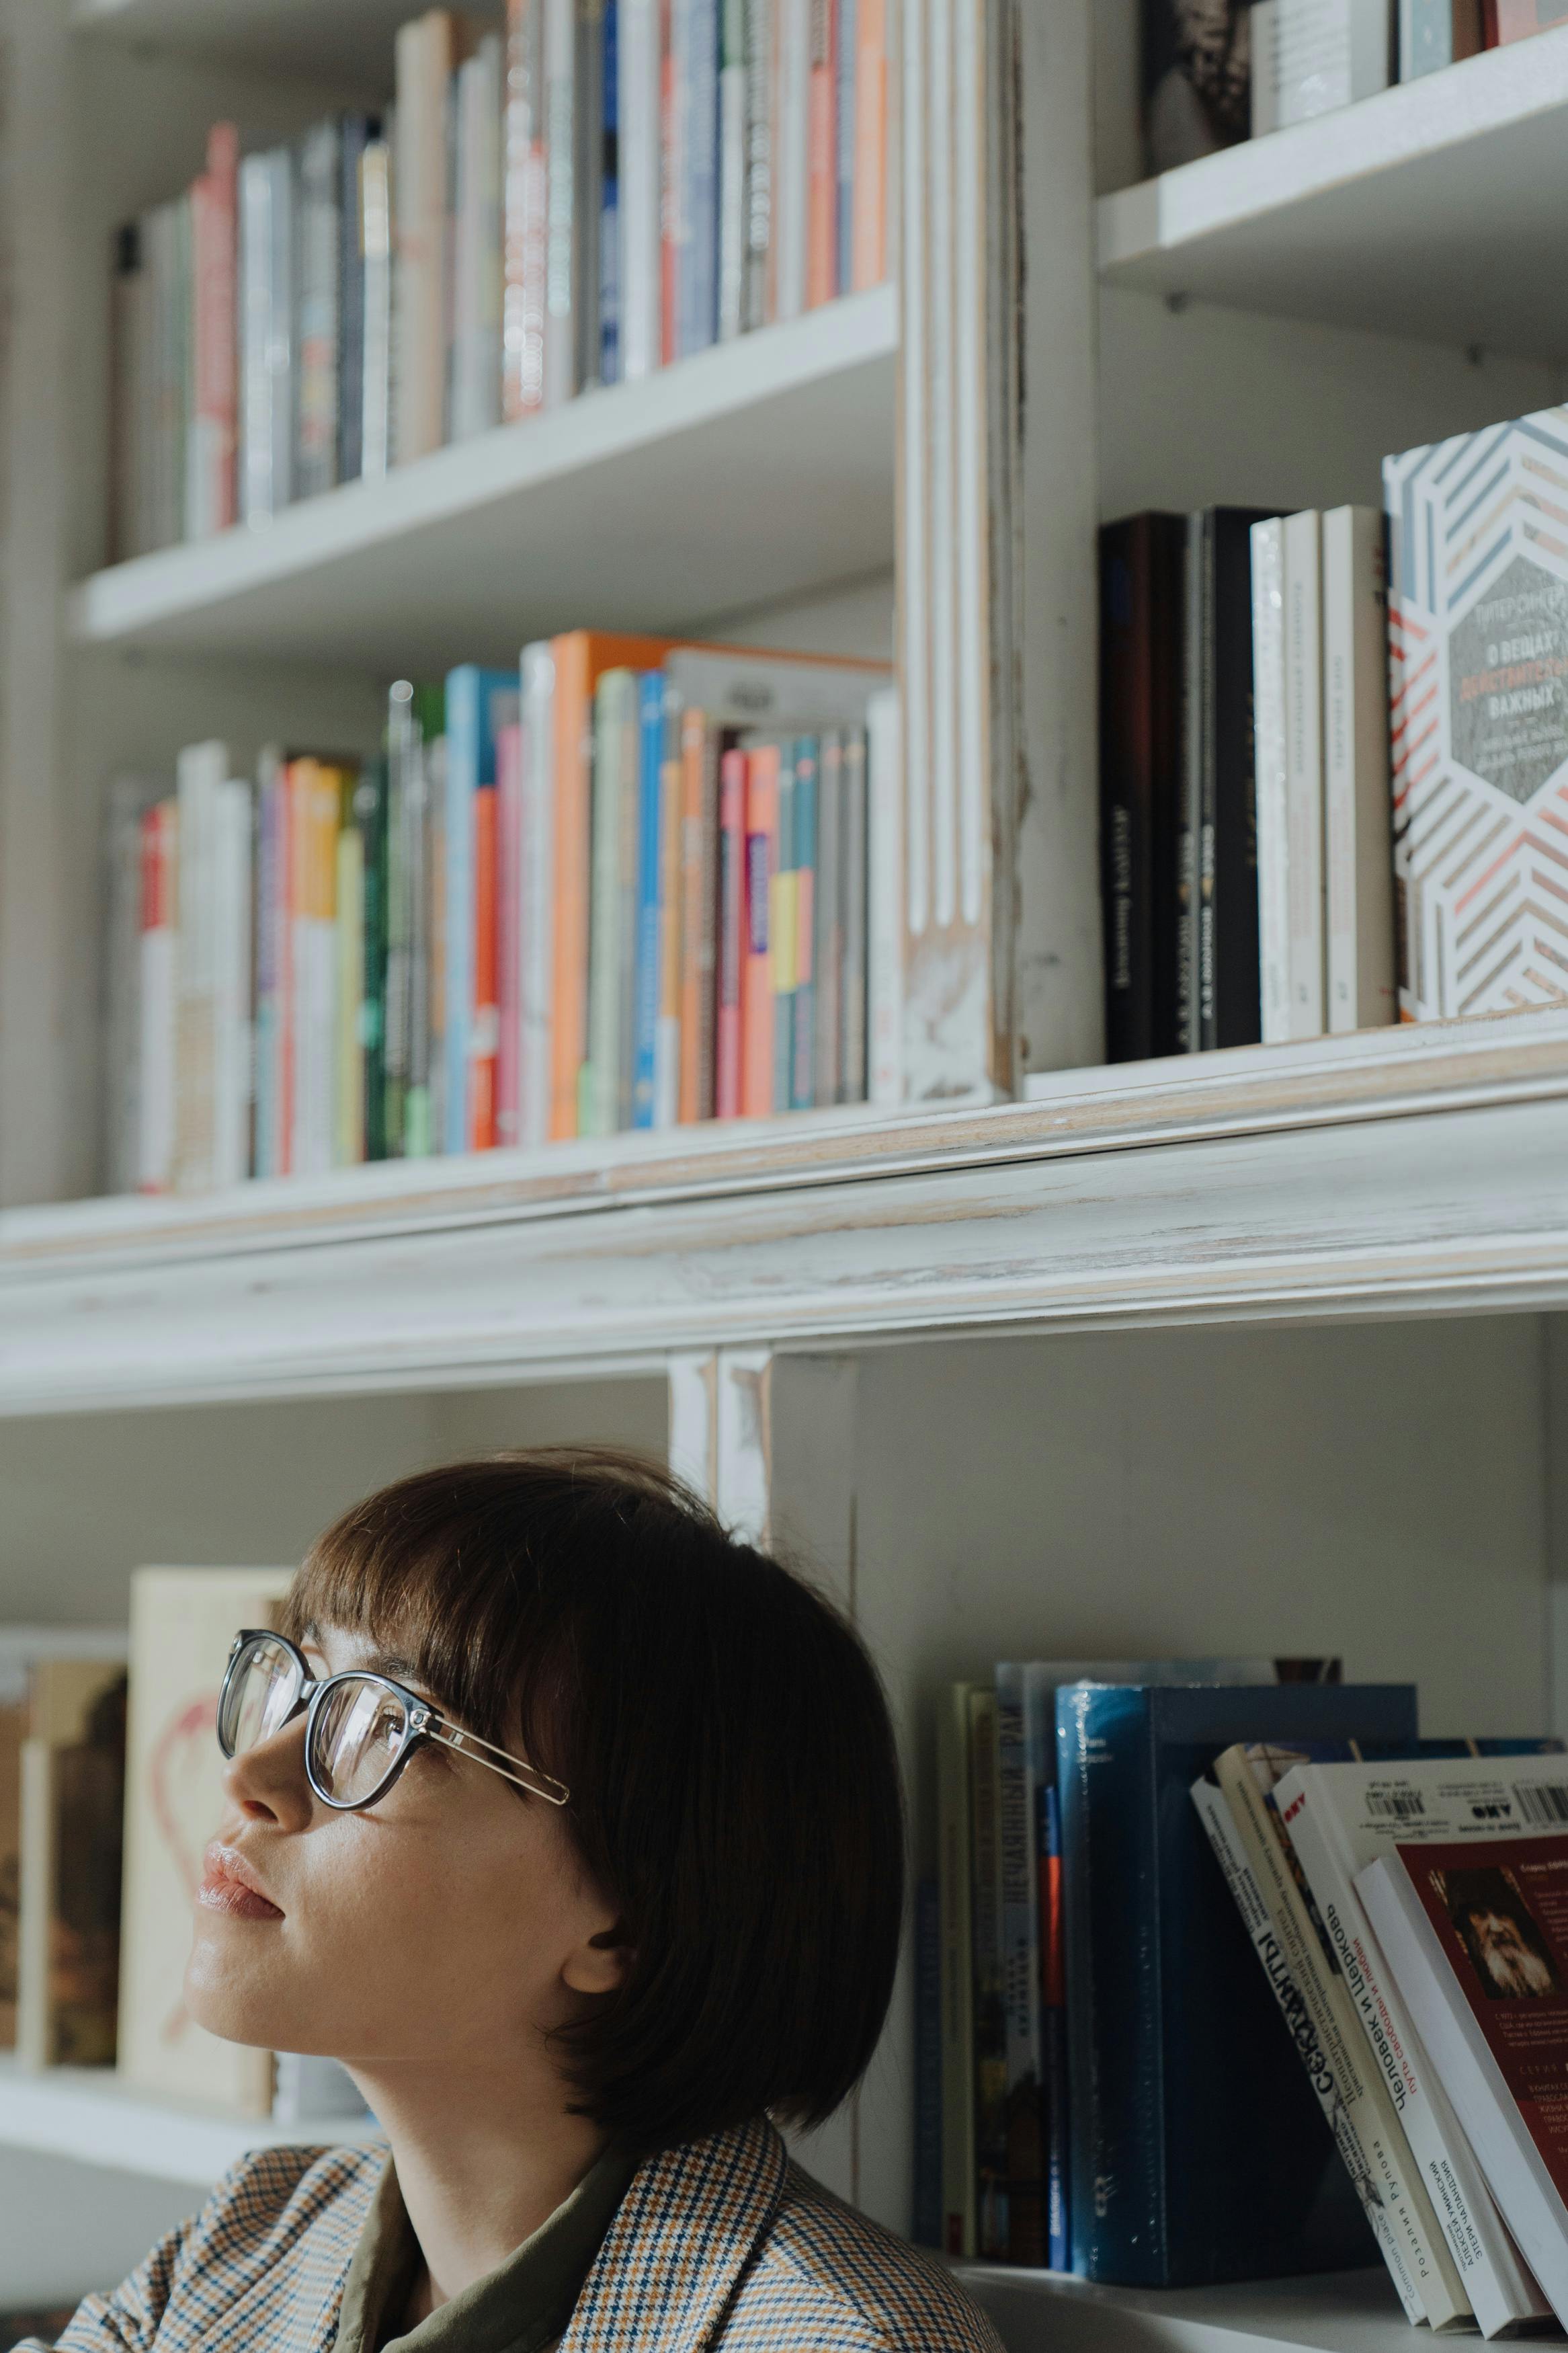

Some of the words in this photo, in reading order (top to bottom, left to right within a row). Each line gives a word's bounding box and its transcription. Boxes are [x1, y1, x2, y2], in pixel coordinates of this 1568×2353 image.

[1323, 1903, 1366, 1997] Церковь
[1352, 1937, 1374, 1983] любви
[1360, 1995, 1372, 2013] и
[1370, 1985, 1378, 1995] и
[1375, 1996, 1404, 2060] свободы
[1366, 2014, 1409, 2111] Человек
[1401, 2061, 1417, 2095] путь
[1371, 2140, 1399, 2200] Рупова
[1428, 2161, 1456, 2217] УМИНСКИЙ
[1439, 2159, 1469, 2223] ЧАЛАНДЗИЯ
[1377, 2213, 1395, 2244] place
[1398, 2206, 1430, 2277] Розалия
[1450, 2217, 1474, 2266] АЛЕКСЕЙ
[1464, 2225, 1483, 2260] ЭТЕРИ
[1391, 2247, 1415, 2299] common
